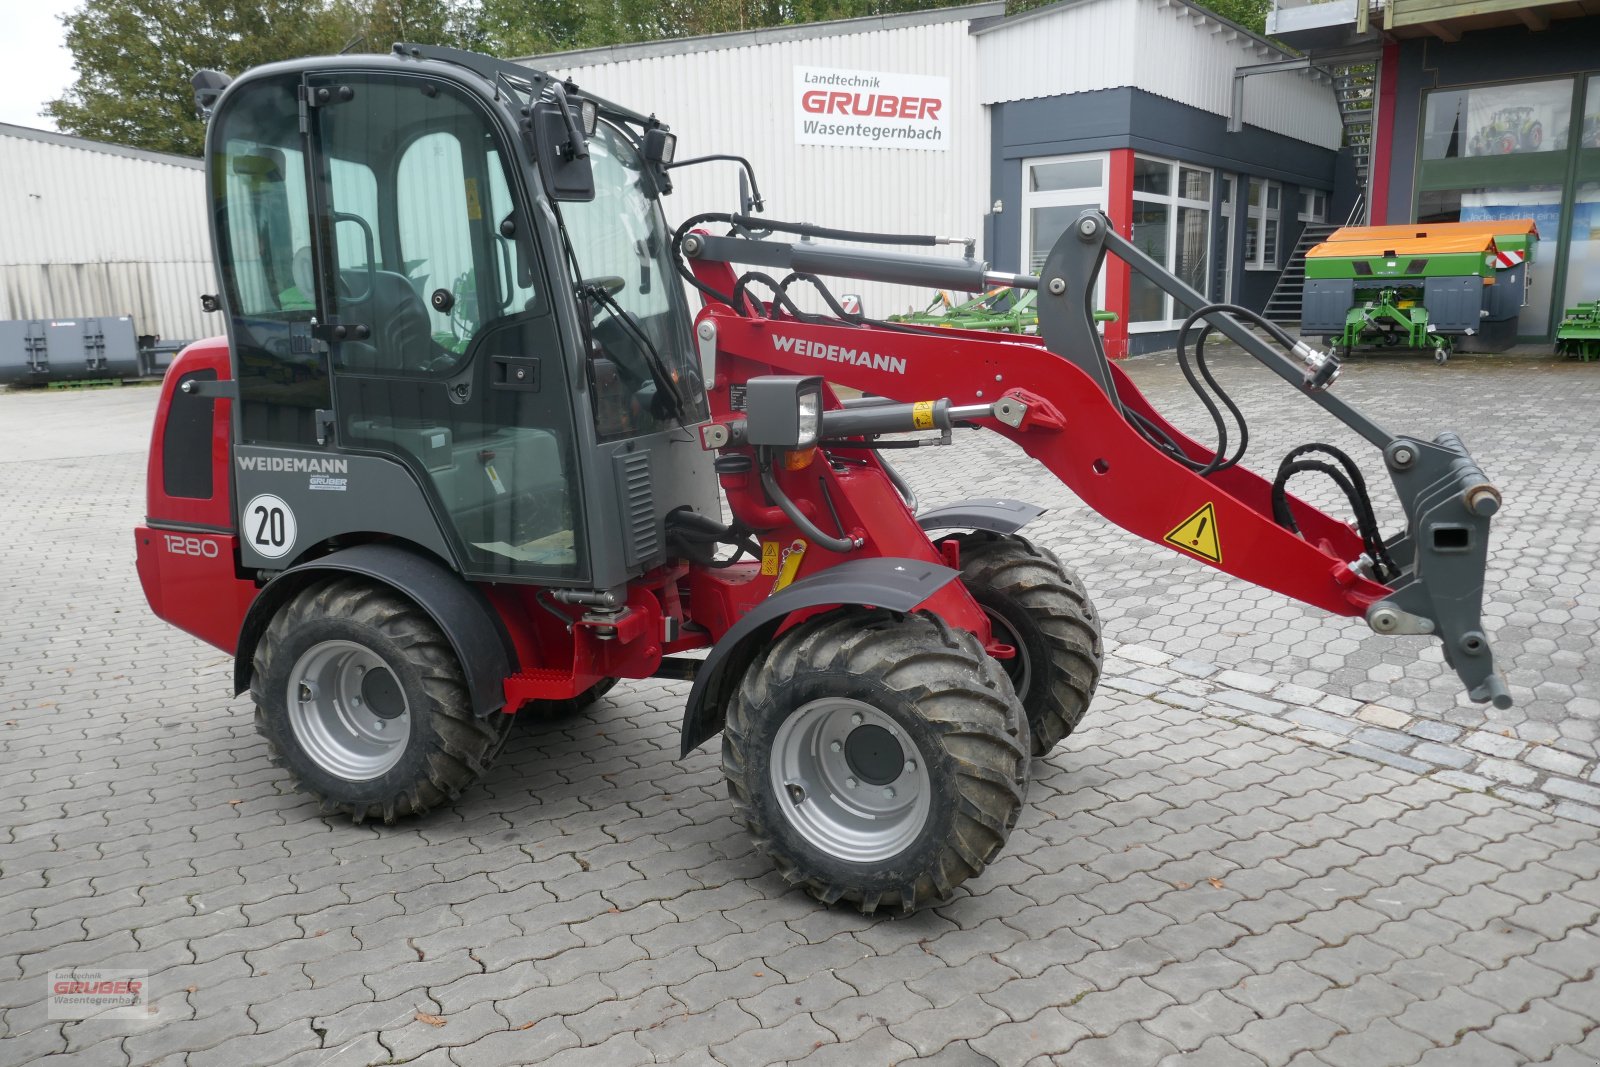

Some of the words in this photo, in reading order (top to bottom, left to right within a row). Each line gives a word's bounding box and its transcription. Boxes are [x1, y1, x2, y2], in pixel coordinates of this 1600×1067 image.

[804, 72, 880, 88] Landtechnik
[802, 90, 942, 121] GRUBER
[803, 120, 942, 141] Wasentegernbach
[771, 334, 907, 375] WEIDEMANN
[237, 456, 348, 474] WEIDEMANN
[309, 478, 348, 486] GRUBER
[254, 505, 286, 547] 20
[163, 534, 219, 558] 1280
